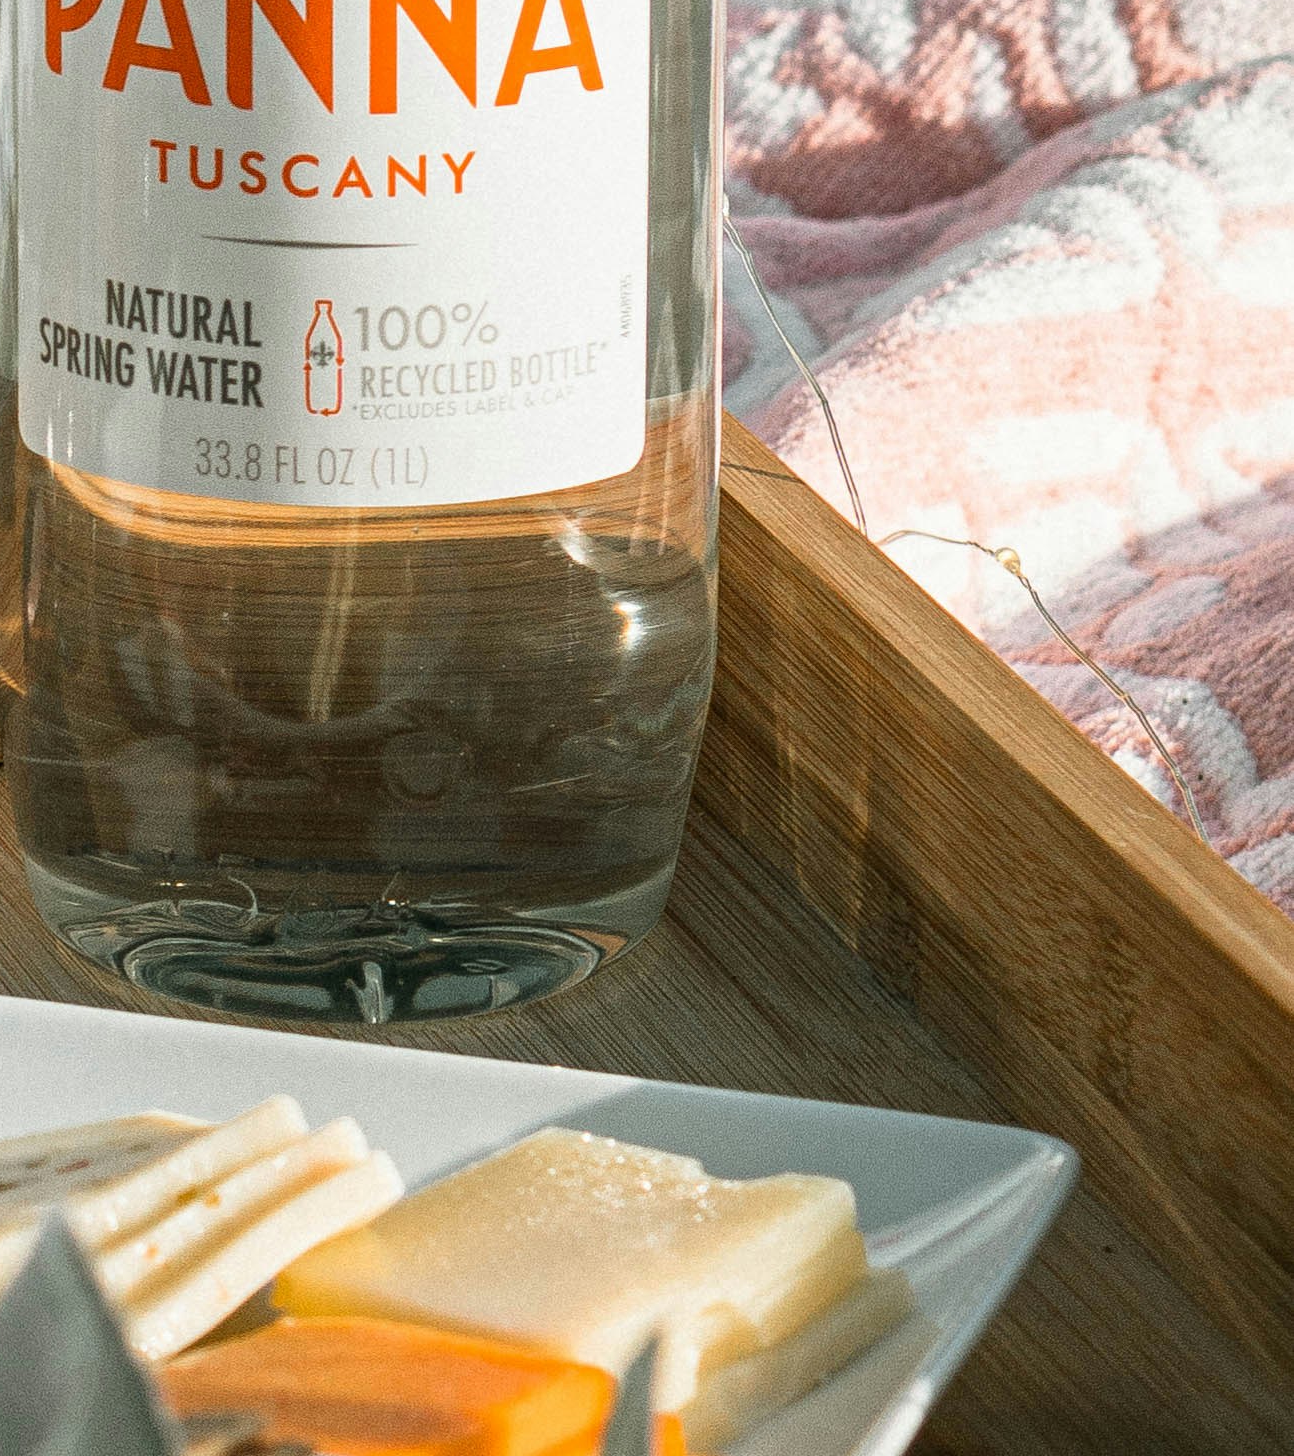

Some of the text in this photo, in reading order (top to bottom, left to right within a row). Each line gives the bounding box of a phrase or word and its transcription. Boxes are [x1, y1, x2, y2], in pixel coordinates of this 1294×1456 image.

[149, 140, 477, 199] TUSCANY
[106, 278, 262, 347] NATURAL
[354, 300, 499, 352] 100%
[39, 316, 264, 408] SPRING WATER
[360, 360, 497, 398] RECYCLED
[195, 438, 429, 489] 33.8 FL OZ (1L)
